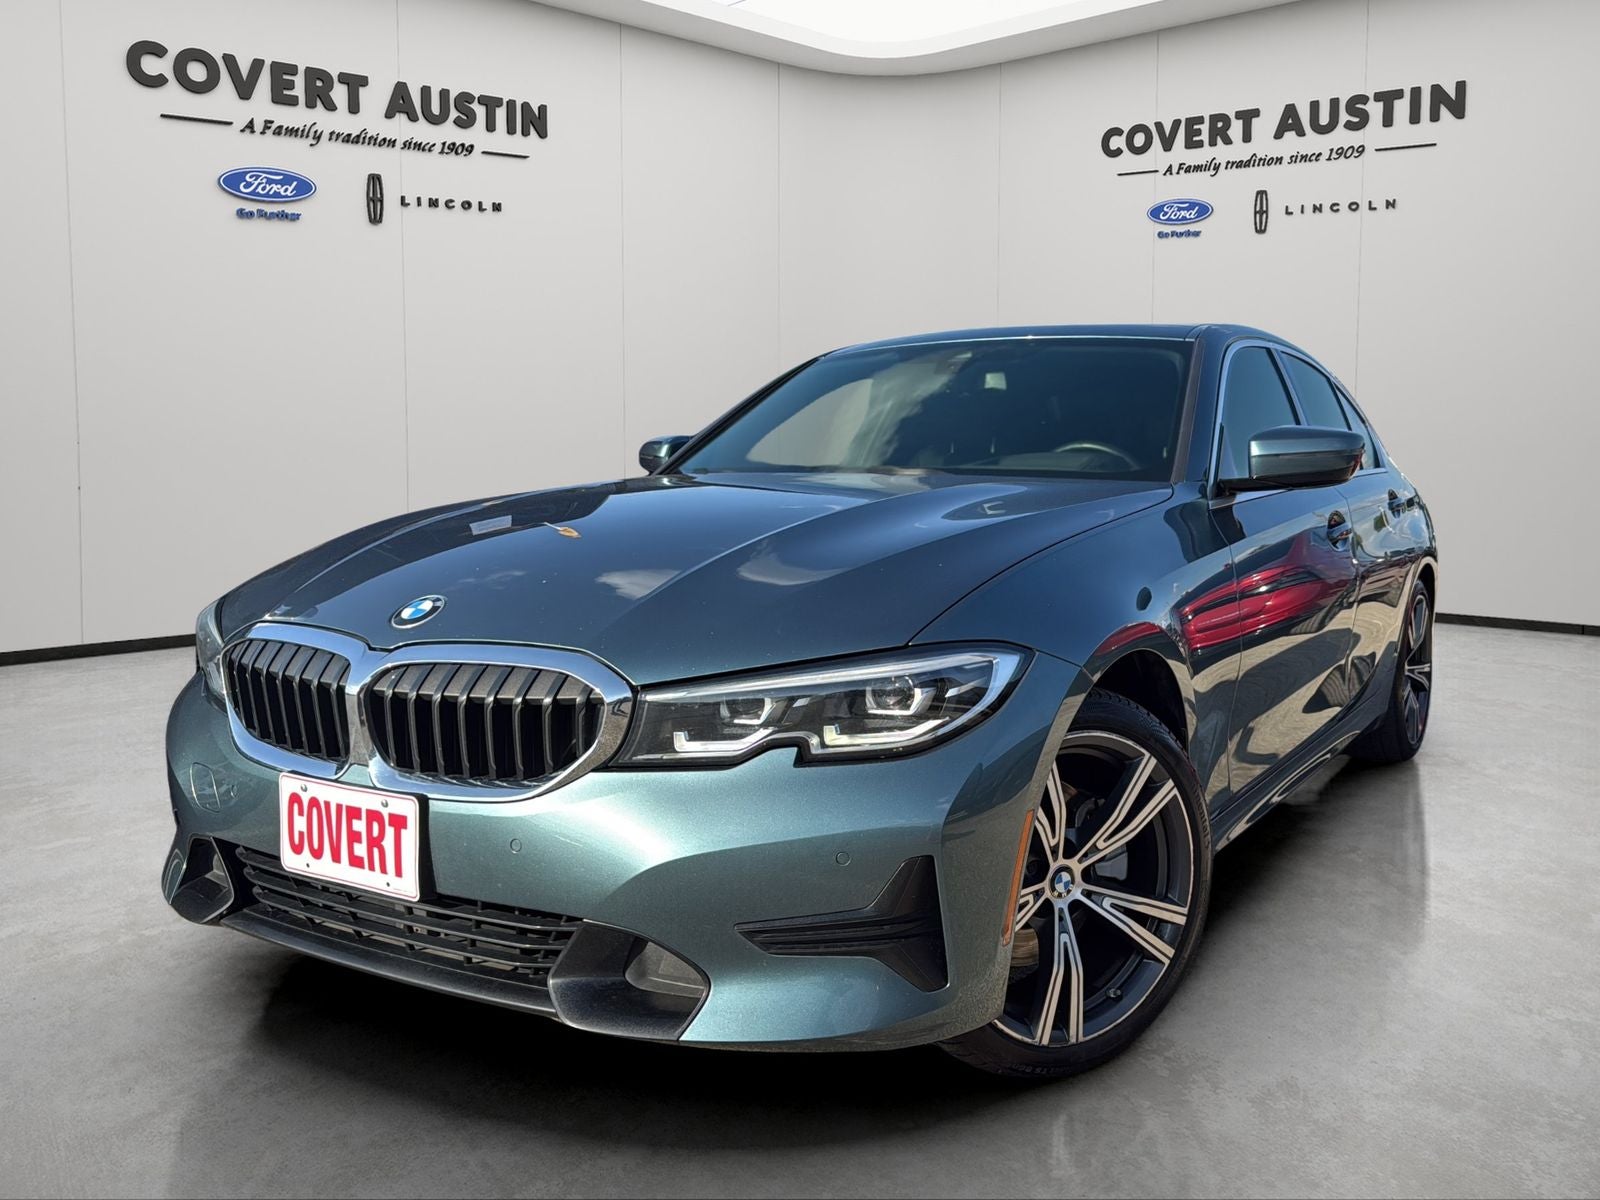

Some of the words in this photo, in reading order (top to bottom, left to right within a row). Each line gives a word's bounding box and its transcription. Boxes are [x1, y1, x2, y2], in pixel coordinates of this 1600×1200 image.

[125, 39, 369, 116] COVERT
[384, 80, 549, 141] AUSTIN
[1100, 108, 1261, 159] COVERT
[1272, 79, 1468, 141] AUSTIN
[239, 117, 257, 135] A
[259, 118, 325, 148] Family
[327, 127, 398, 149] tradition
[399, 136, 437, 154] since
[437, 140, 475, 158] 1909
[1162, 163, 1174, 177] A
[1175, 156, 1222, 178] Family
[1224, 152, 1284, 170] tradition
[1286, 150, 1323, 165] since
[1324, 143, 1366, 162] 1909
[239, 171, 298, 197] Ford
[399, 194, 503, 214] LINCOLN
[1159, 203, 1199, 220] Ford
[1284, 198, 1397, 217] LINCOLN
[1156, 230, 1170, 239] Go
[287, 791, 408, 878] COVERT
